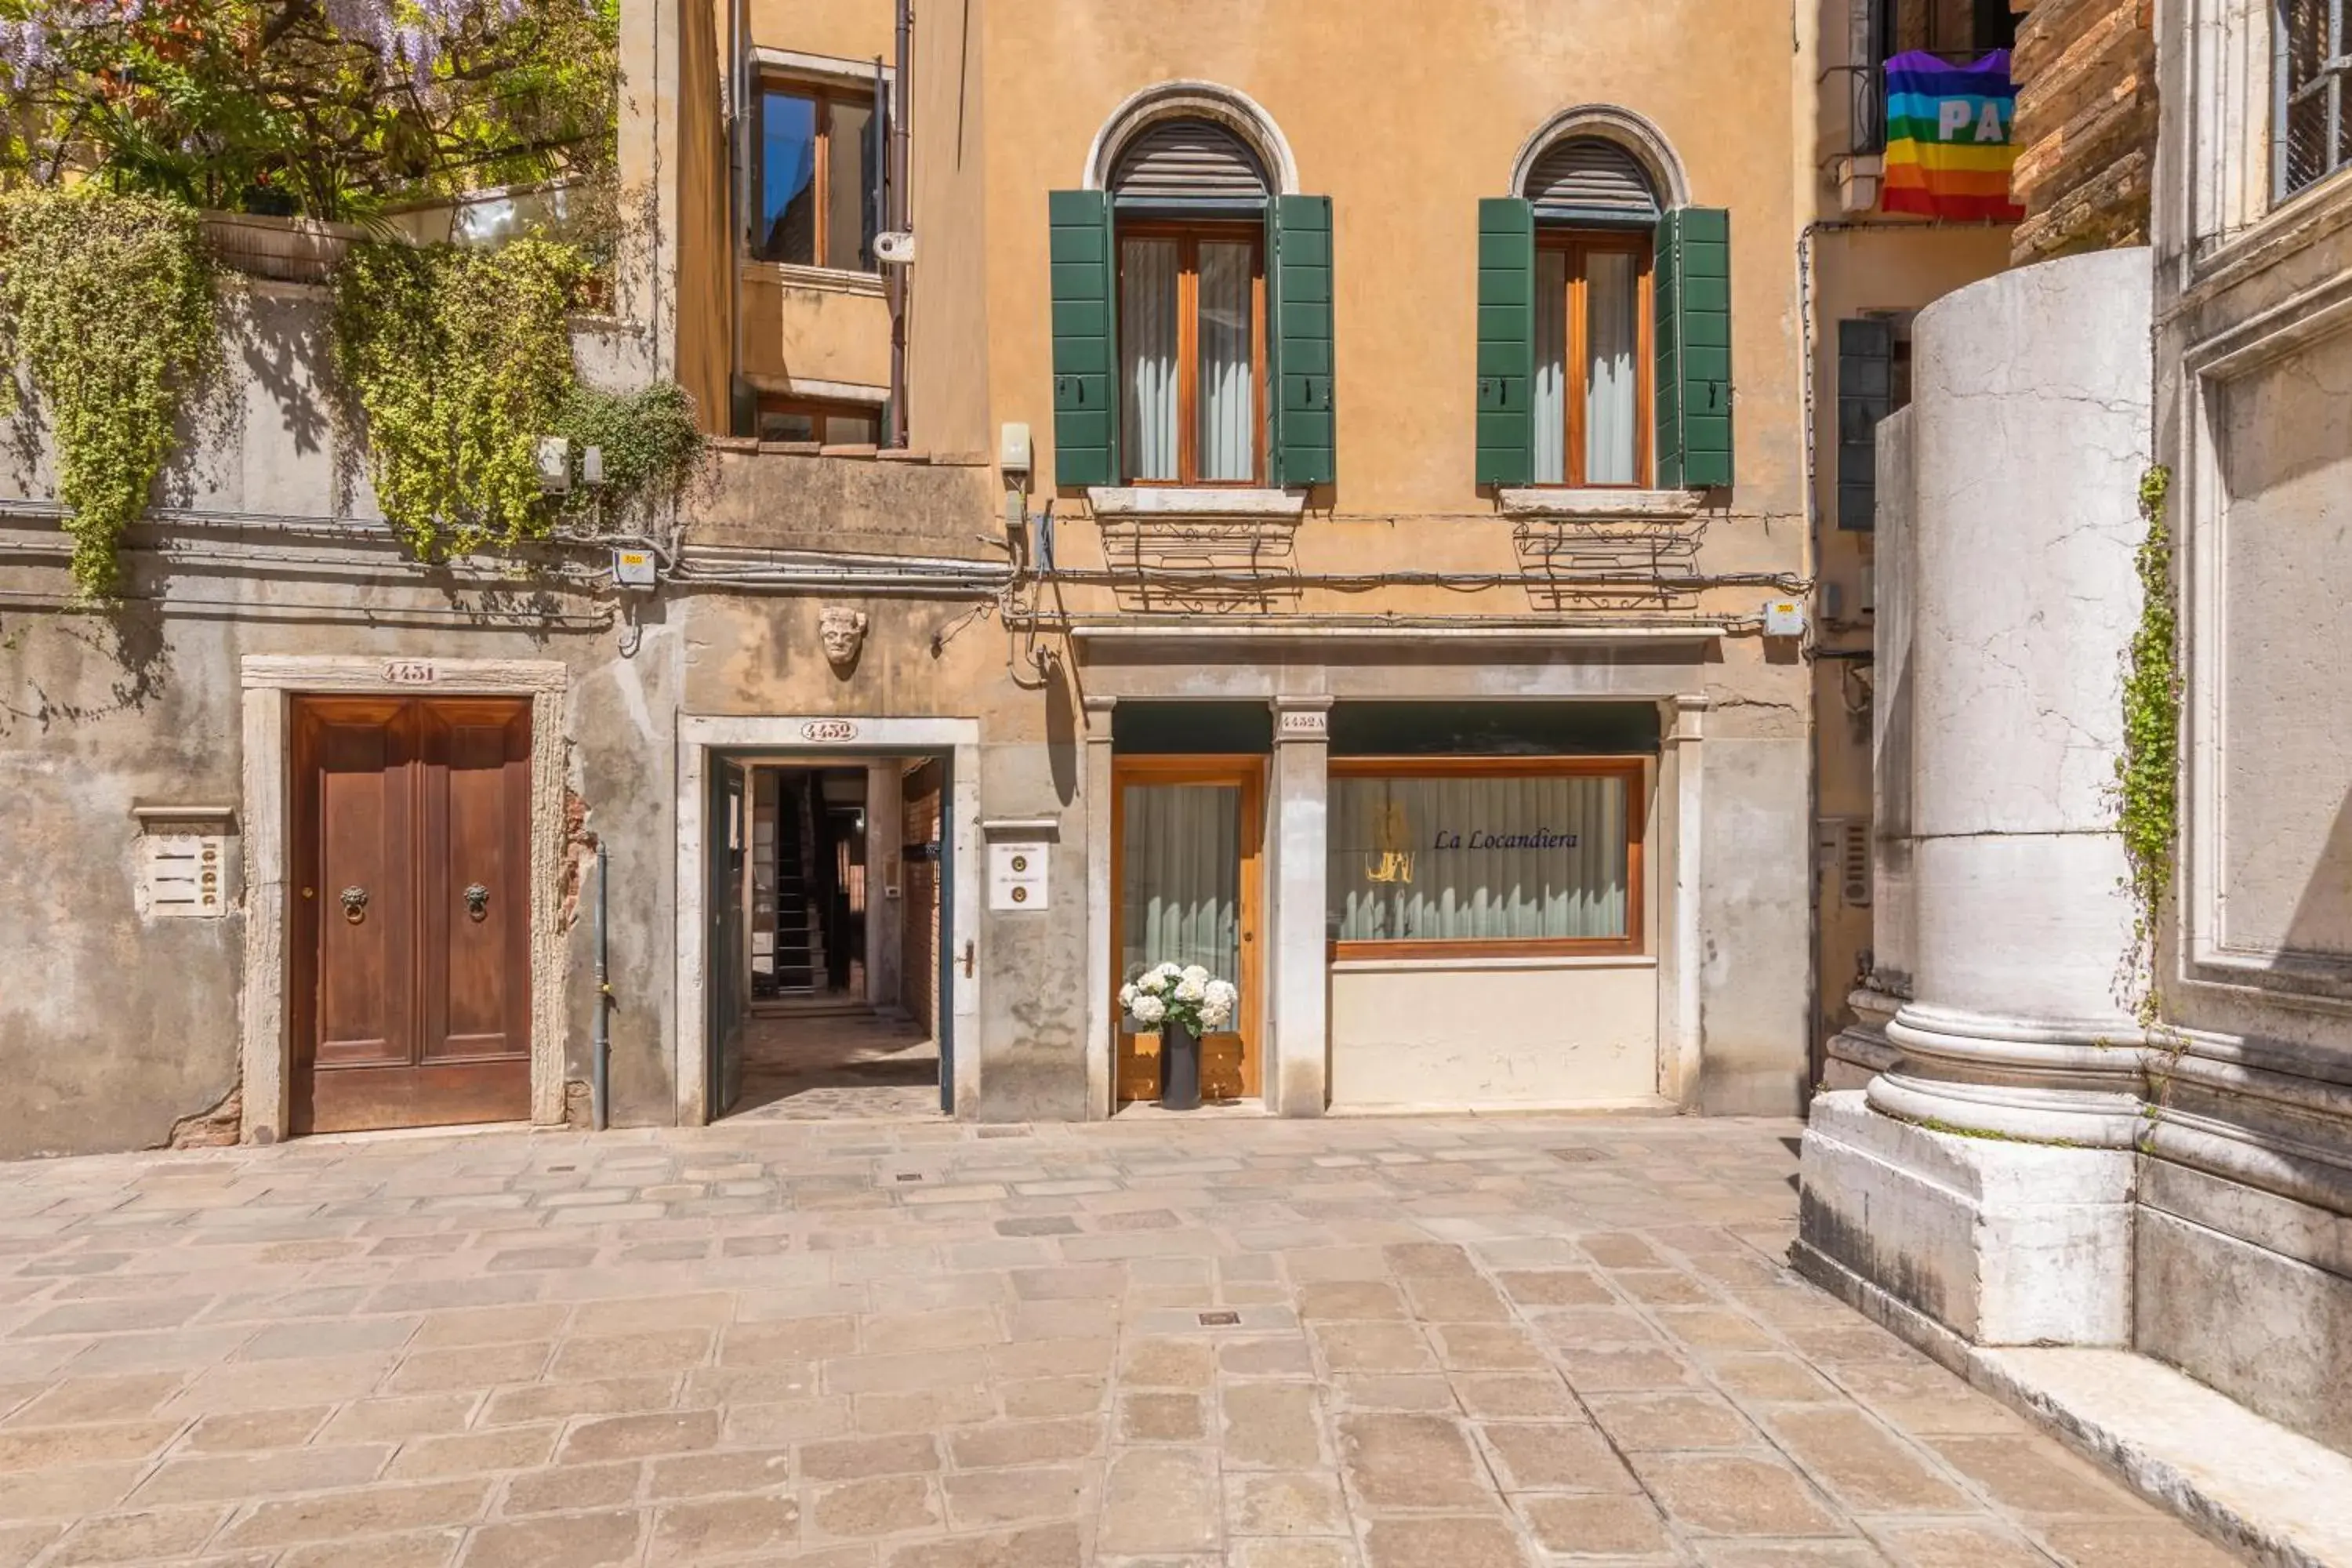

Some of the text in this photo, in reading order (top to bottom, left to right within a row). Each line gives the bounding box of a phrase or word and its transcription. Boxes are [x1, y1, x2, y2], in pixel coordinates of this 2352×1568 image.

[1939, 100, 2014, 142] PA
[1434, 827, 1578, 849] La Locandiera
